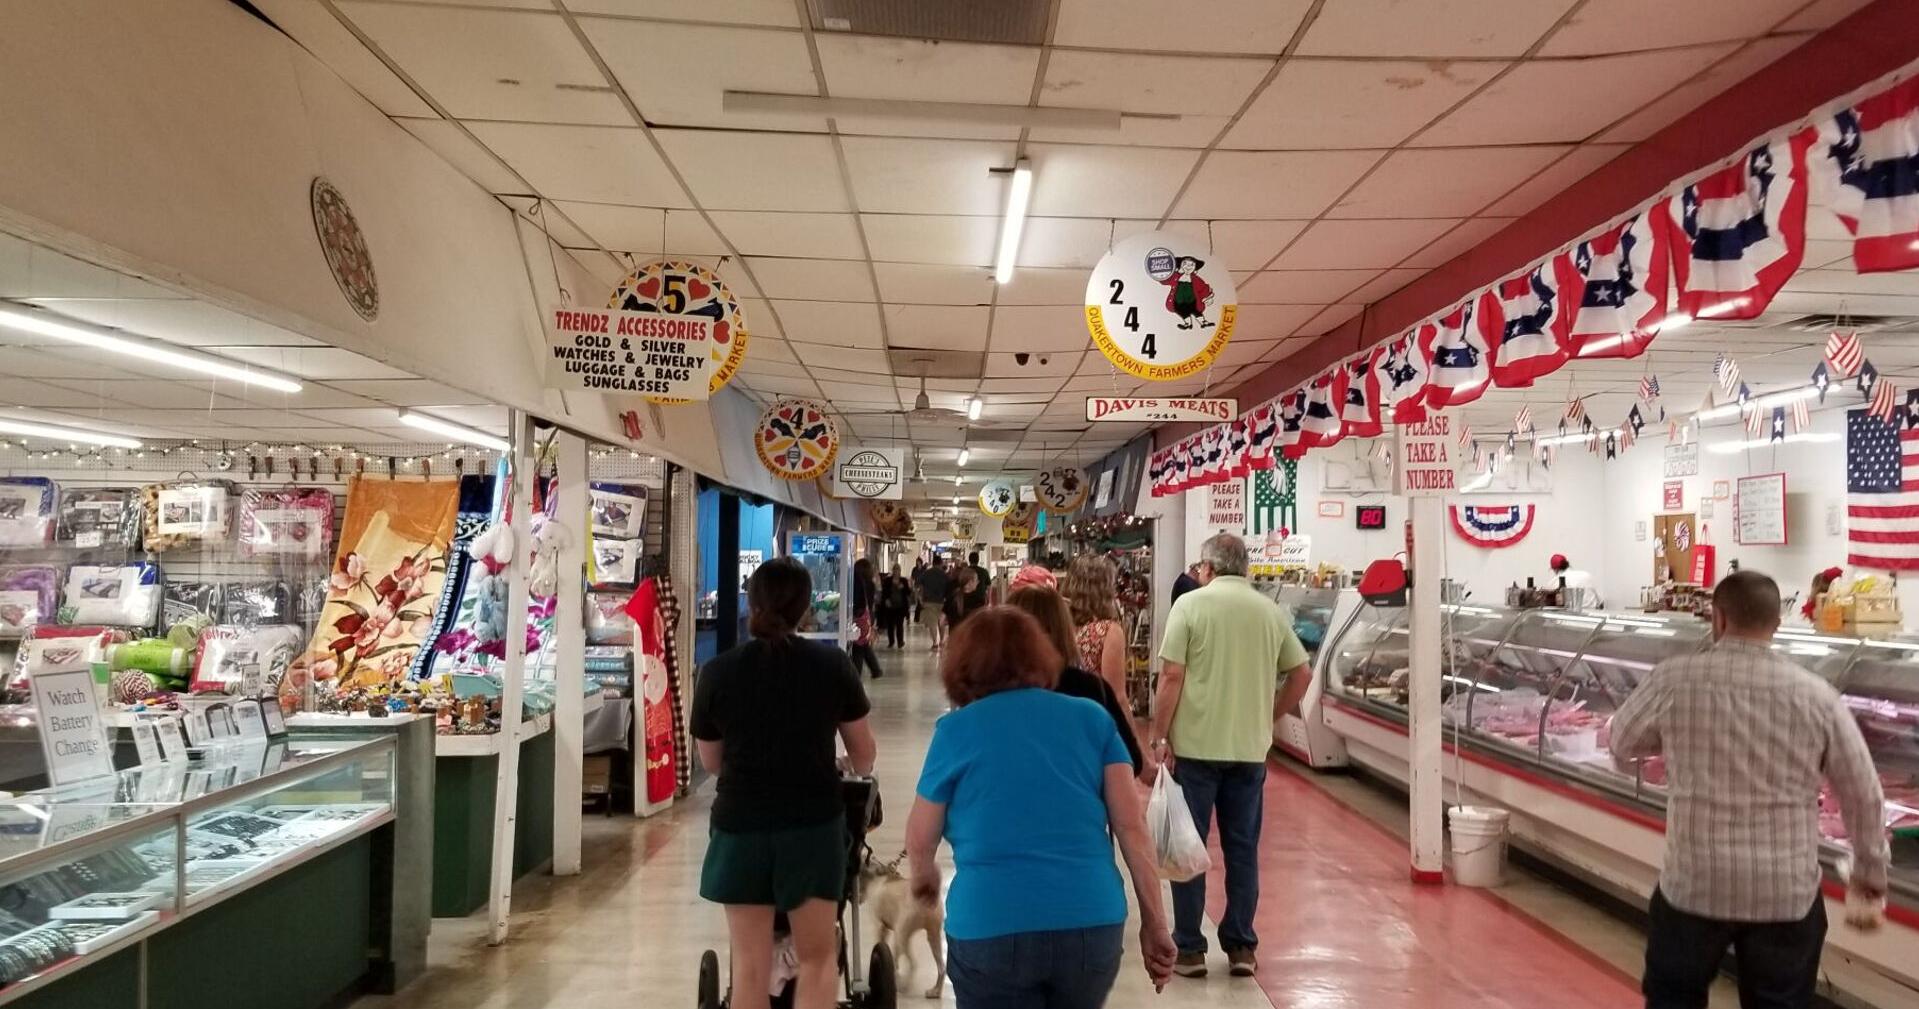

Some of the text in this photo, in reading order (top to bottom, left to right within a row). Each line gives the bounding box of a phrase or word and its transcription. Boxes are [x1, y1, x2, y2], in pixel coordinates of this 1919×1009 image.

[663, 274, 687, 314] 5
[556, 310, 706, 341] TRENDZ ACCESSORIES
[575, 334, 686, 354] GOLD & SILVER
[1088, 306, 1235, 378] QUAKERTOWN FARMERS MARKET
[554, 346, 705, 369] WATCHES & JEWELRY
[717, 331, 746, 382] MARKET
[565, 360, 690, 382] LUGGAGE & BAGS
[584, 375, 670, 393] SUNGLASSES
[790, 408, 804, 430] 4
[1094, 399, 1230, 420] DAVIS MEATS
[1405, 416, 1449, 436] PLEASE
[1406, 442, 1448, 463] TAKE A
[1212, 484, 1240, 495] PLEASE
[1406, 470, 1454, 490] NUMBER
[1214, 499, 1240, 510] TAKE A
[1209, 513, 1244, 524] NUMBER
[1360, 509, 1382, 526] 80
[48, 687, 86, 706] Watch
[50, 714, 94, 732] Battery
[55, 738, 98, 757] Change
